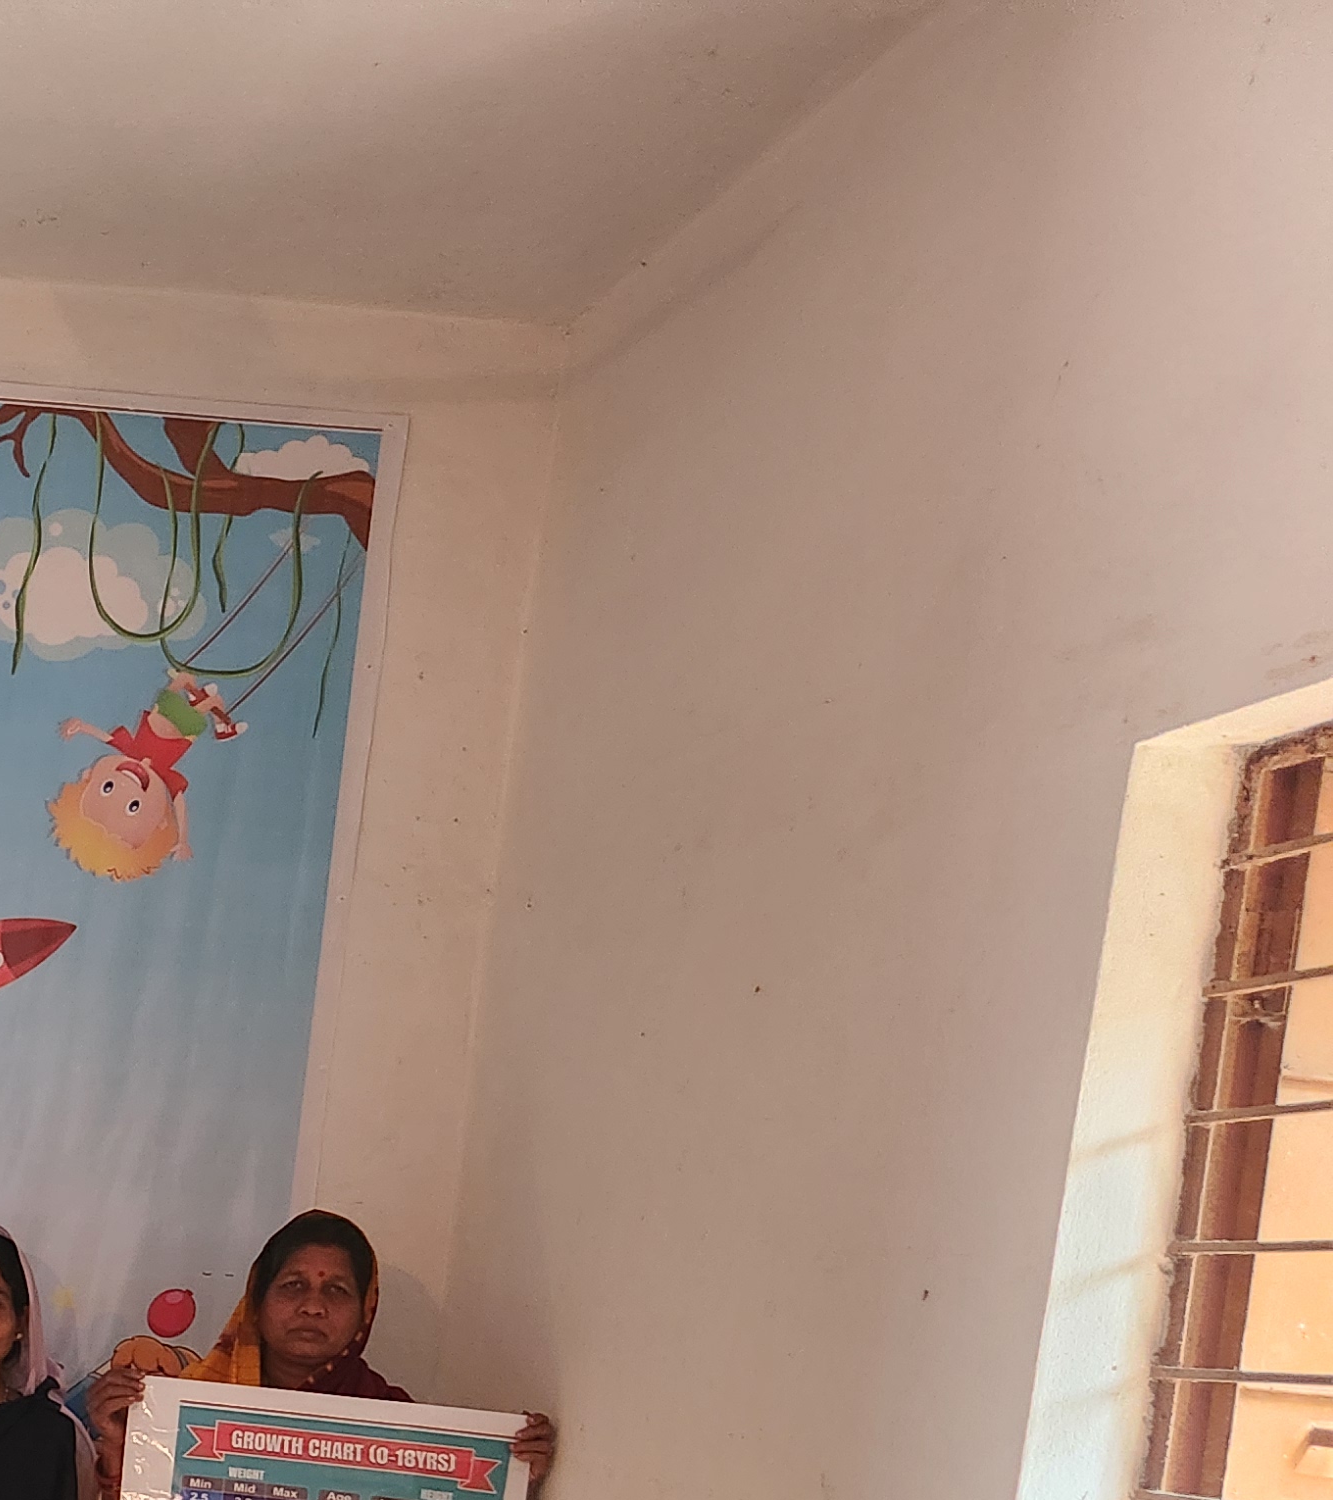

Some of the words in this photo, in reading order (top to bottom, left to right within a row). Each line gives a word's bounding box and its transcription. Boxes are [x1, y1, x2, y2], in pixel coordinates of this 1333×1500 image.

[232, 1430, 304, 1453] GROWTH
[309, 1440, 364, 1462] CHART
[369, 1446, 456, 1472] (0-18YRS)
[229, 1467, 265, 1480] WEIGHT
[189, 1478, 212, 1489] Min
[233, 1482, 256, 1494] Mid
[273, 1487, 298, 1498] Max
